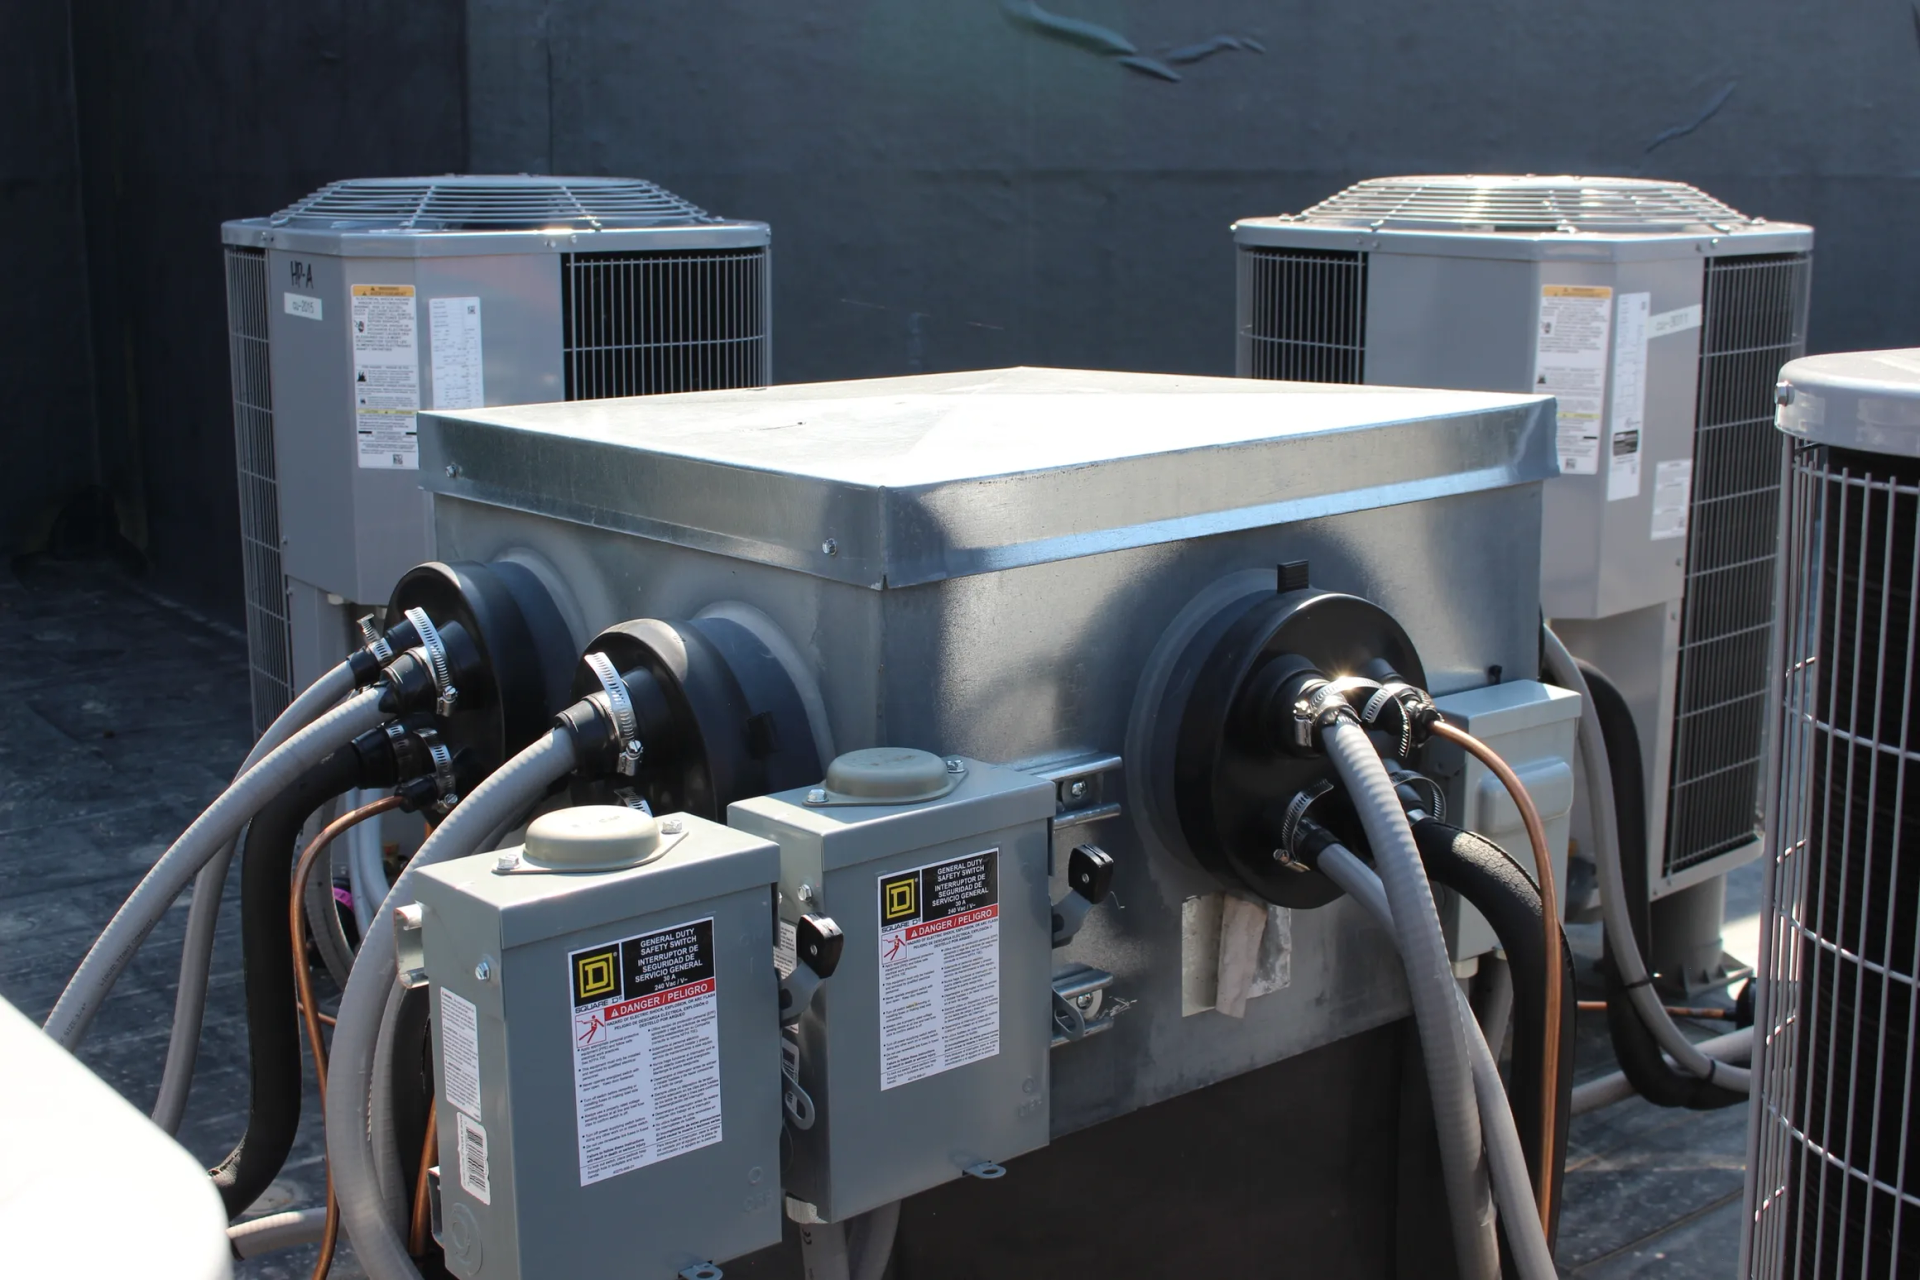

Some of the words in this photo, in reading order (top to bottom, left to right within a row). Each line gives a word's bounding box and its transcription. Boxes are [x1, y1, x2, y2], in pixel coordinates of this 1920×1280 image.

[938, 862, 966, 875] GENERAL
[967, 858, 983, 868] DUTY
[938, 871, 961, 882] SAFETY
[962, 865, 984, 876] SWITCH
[935, 876, 977, 892] INTERRUPTOR
[978, 873, 985, 881] DE
[939, 883, 974, 898] SEGURIDAD
[975, 881, 982, 889] DE
[932, 894, 960, 907] SERVICIO
[961, 887, 988, 899] GENERAL
[882, 921, 910, 933] SQUARE
[919, 920, 951, 936] DANGER
[959, 909, 992, 925] PELIGRO
[640, 933, 674, 948] GENERAL
[676, 928, 695, 939] DUTY
[641, 942, 668, 955] SAFETY
[670, 935, 697, 948] SWITCH
[638, 947, 688, 966] INTERRUPTOR
[689, 944, 699, 953] DE
[643, 956, 685, 973] SEGURIDAD
[686, 953, 695, 962] DE
[635, 968, 669, 983] SERVICIO
[670, 959, 703, 974] GENERAL
[575, 999, 609, 1014] SQUARE
[620, 997, 659, 1015] DANGER
[662, 995, 665, 1004] /
[668, 983, 708, 1002] PELIGRO
